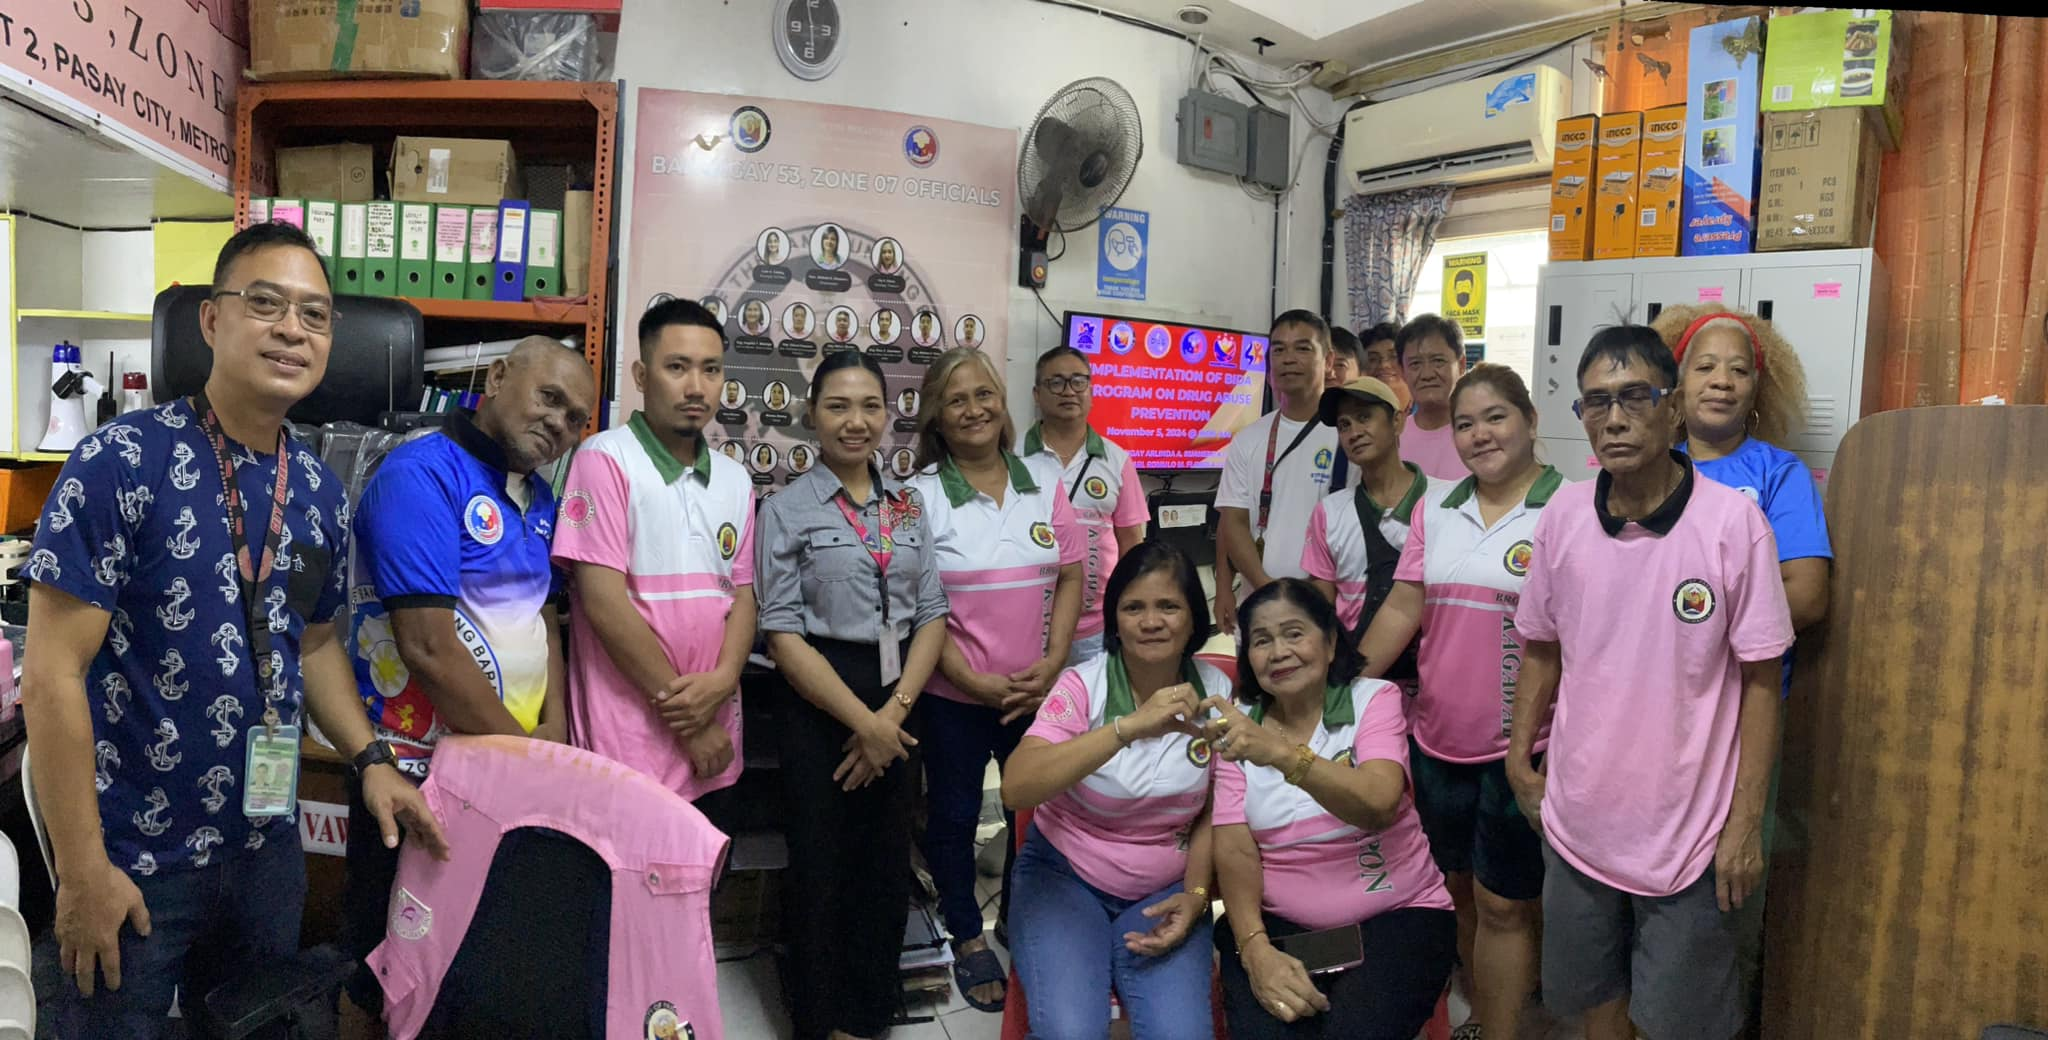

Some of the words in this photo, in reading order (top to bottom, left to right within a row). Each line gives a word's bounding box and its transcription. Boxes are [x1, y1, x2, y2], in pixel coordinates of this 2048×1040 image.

[791, 20, 802, 32] 9
[821, 24, 831, 36] 3
[804, 47, 815, 58] 6
[54, 43, 126, 107] PASAY
[133, 90, 176, 141] CITY,
[179, 117, 230, 165] METRO
[811, 168, 868, 191] ZONE
[874, 175, 899, 194] 07
[904, 178, 1001, 208] OFFICIALS
[1205, 371, 1222, 384] OF
[1224, 373, 1252, 385] BIDA
[1091, 384, 1153, 399] ROGRAM
[1155, 388, 1174, 400] ON
[1177, 389, 1213, 403] DRUG
[1214, 392, 1253, 405] ABUSE
[1130, 406, 1211, 421] PREVENTION
[1106, 426, 1154, 437] November
